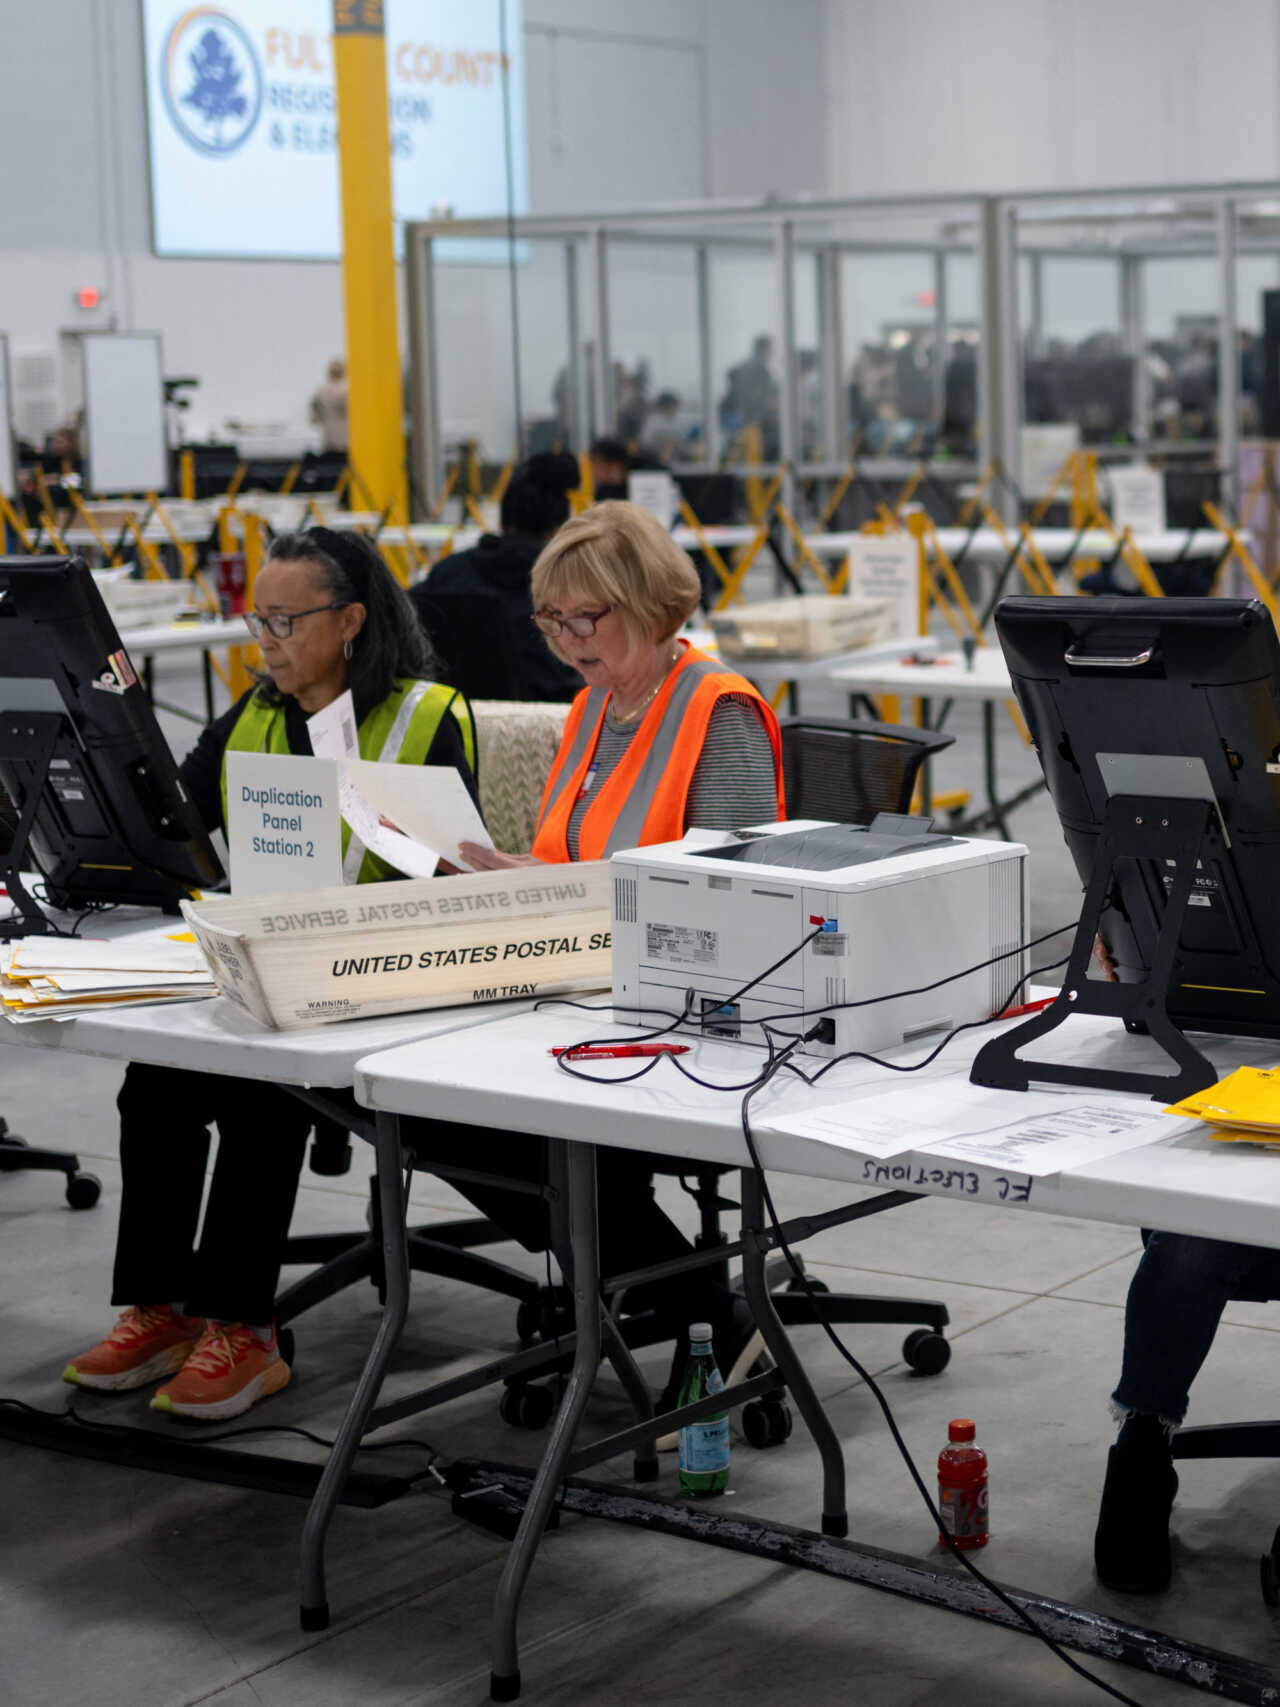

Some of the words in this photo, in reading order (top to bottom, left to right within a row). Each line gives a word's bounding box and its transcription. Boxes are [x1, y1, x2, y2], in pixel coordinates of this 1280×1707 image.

[242, 786, 322, 809] Duplication
[263, 813, 302, 832] Panel
[252, 837, 302, 857] Station
[306, 841, 315, 858] 2
[331, 952, 413, 978] UNITED
[418, 945, 498, 969] STATES
[503, 936, 582, 960] POSTAL
[473, 986, 497, 1001] MM
[500, 983, 539, 997] TRAY
[307, 998, 350, 1010] WARNING
[862, 1160, 980, 1195] ELECTIONS
[994, 1174, 1033, 1203] FC
